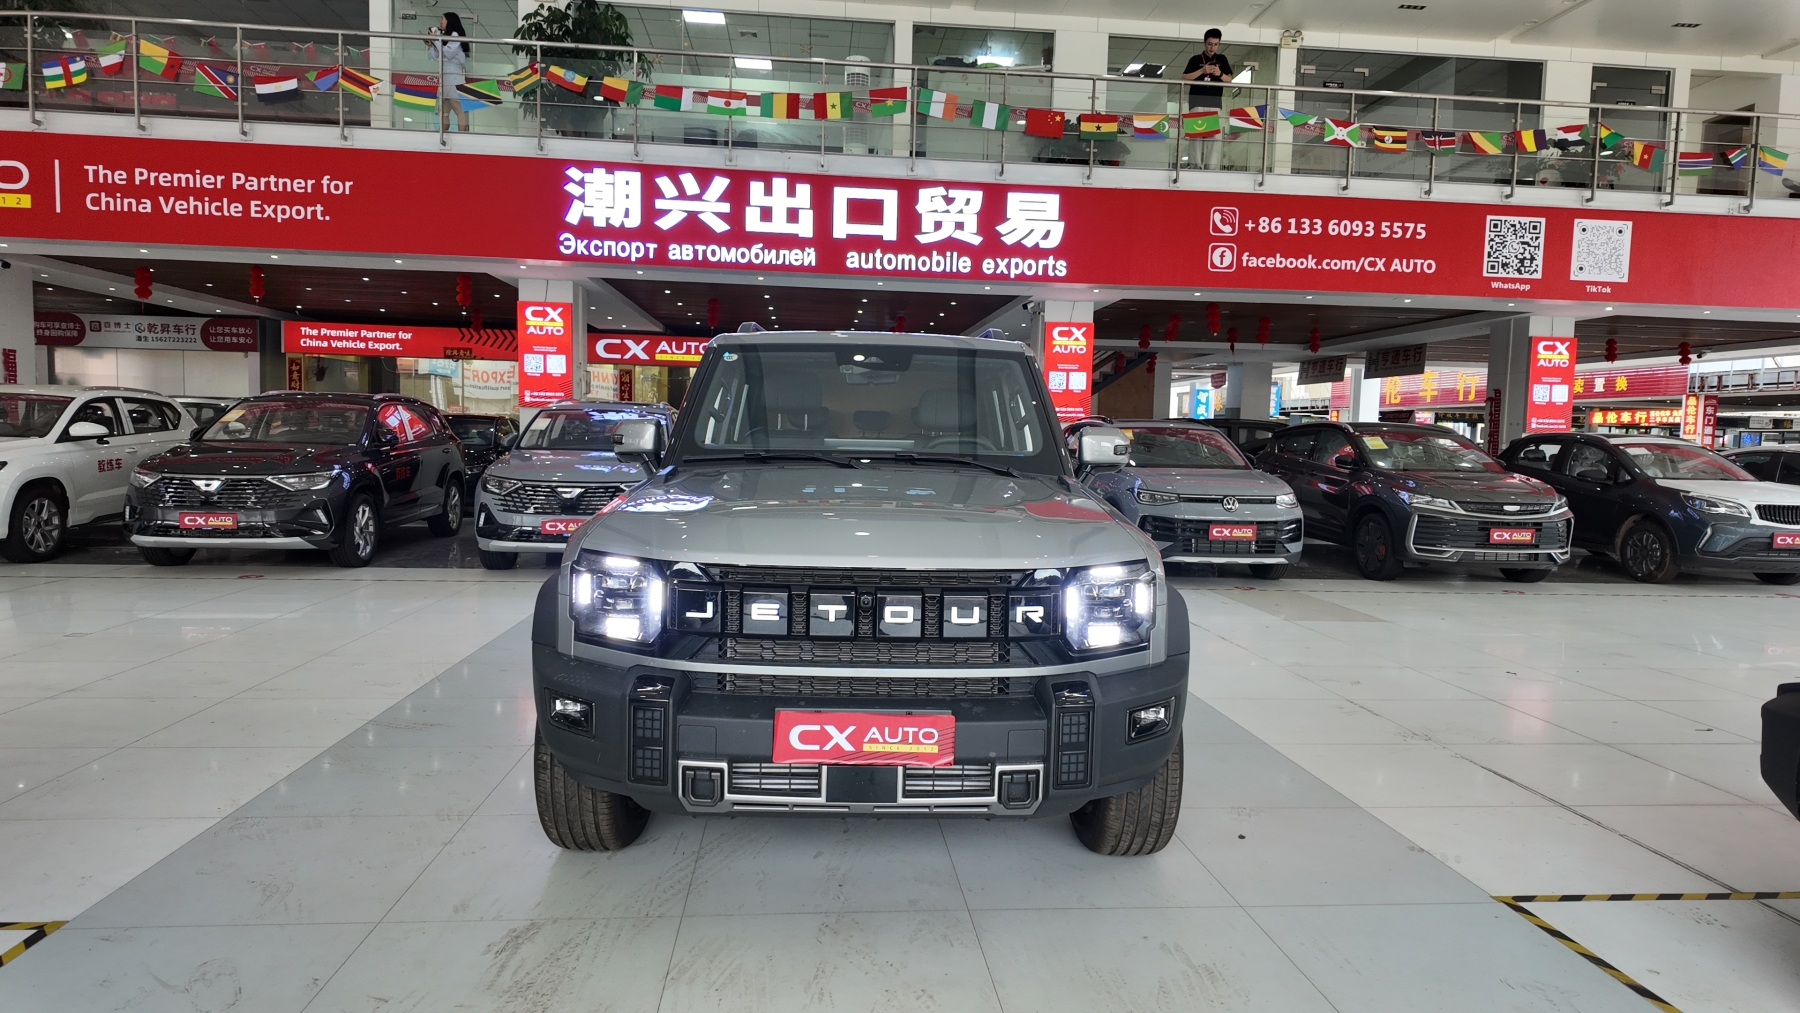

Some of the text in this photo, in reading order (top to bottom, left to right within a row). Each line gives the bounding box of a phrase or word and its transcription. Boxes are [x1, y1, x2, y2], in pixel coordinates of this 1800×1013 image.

[84, 165, 354, 195] The Premier Partner for
[85, 192, 331, 223] China Vehicle Export.
[563, 165, 1067, 249] 潮兴出口贸易
[1245, 215, 1428, 240] +86 133 6093 5575
[558, 232, 817, 268] Экспорт автомобилей
[845, 248, 1069, 279] automobile exports
[1241, 252, 1438, 275] facebook.com/CX AUTO
[1491, 281, 1531, 293] WhatsApp
[1586, 284, 1612, 294] TikTok
[525, 306, 564, 322] CX
[146, 323, 197, 336] 乾昇车行
[300, 327, 412, 340] The Premier Partner for
[526, 326, 564, 336] AUTO
[1052, 327, 1087, 341] CX
[300, 338, 403, 351] China Vehicle Export.
[595, 339, 650, 360] CX
[1052, 346, 1087, 354] AUTO
[1537, 341, 1570, 355] CX
[1381, 347, 1423, 366] 亨通车行
[1537, 359, 1570, 367] AUTO
[1592, 411, 1648, 424] 品伦车行
[1685, 396, 1698, 434] 品伦车行
[184, 516, 206, 525] CX
[545, 522, 567, 531] CX
[1212, 527, 1231, 537] CX
[1493, 532, 1511, 540] CX
[1776, 536, 1794, 544] CX
[685, 600, 1045, 625] JETOUR
[788, 724, 939, 752] CX AUTO
